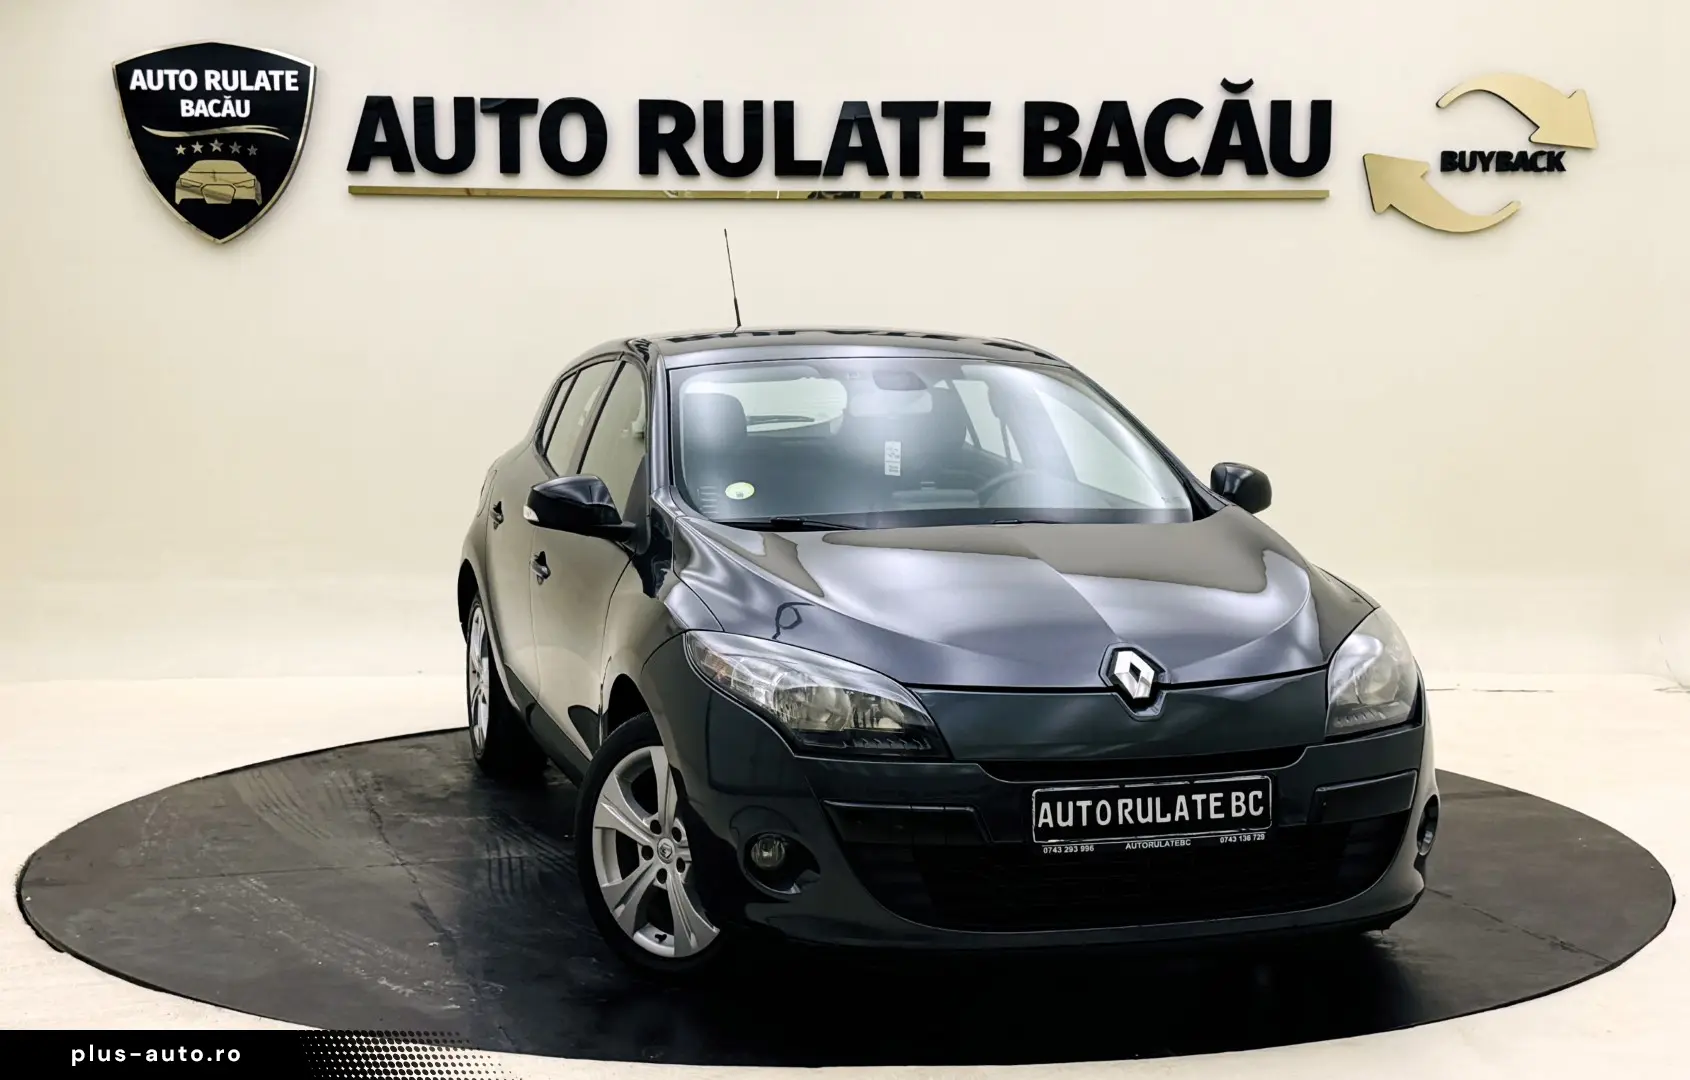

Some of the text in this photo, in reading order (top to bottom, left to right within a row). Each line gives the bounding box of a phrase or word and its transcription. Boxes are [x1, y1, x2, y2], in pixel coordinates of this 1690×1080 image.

[129, 68, 299, 92] AUTO RULATE
[179, 94, 251, 119] BACĂU
[346, 77, 1332, 179] AUTO RULATE BACĂU
[1440, 150, 1567, 173] BUYBACK
[1037, 790, 1264, 829] AUTO RULATE BC
[1043, 846, 1062, 854] 0743
[1125, 839, 1191, 850] AUTORULATEBC
[1219, 836, 1237, 844] 0743
